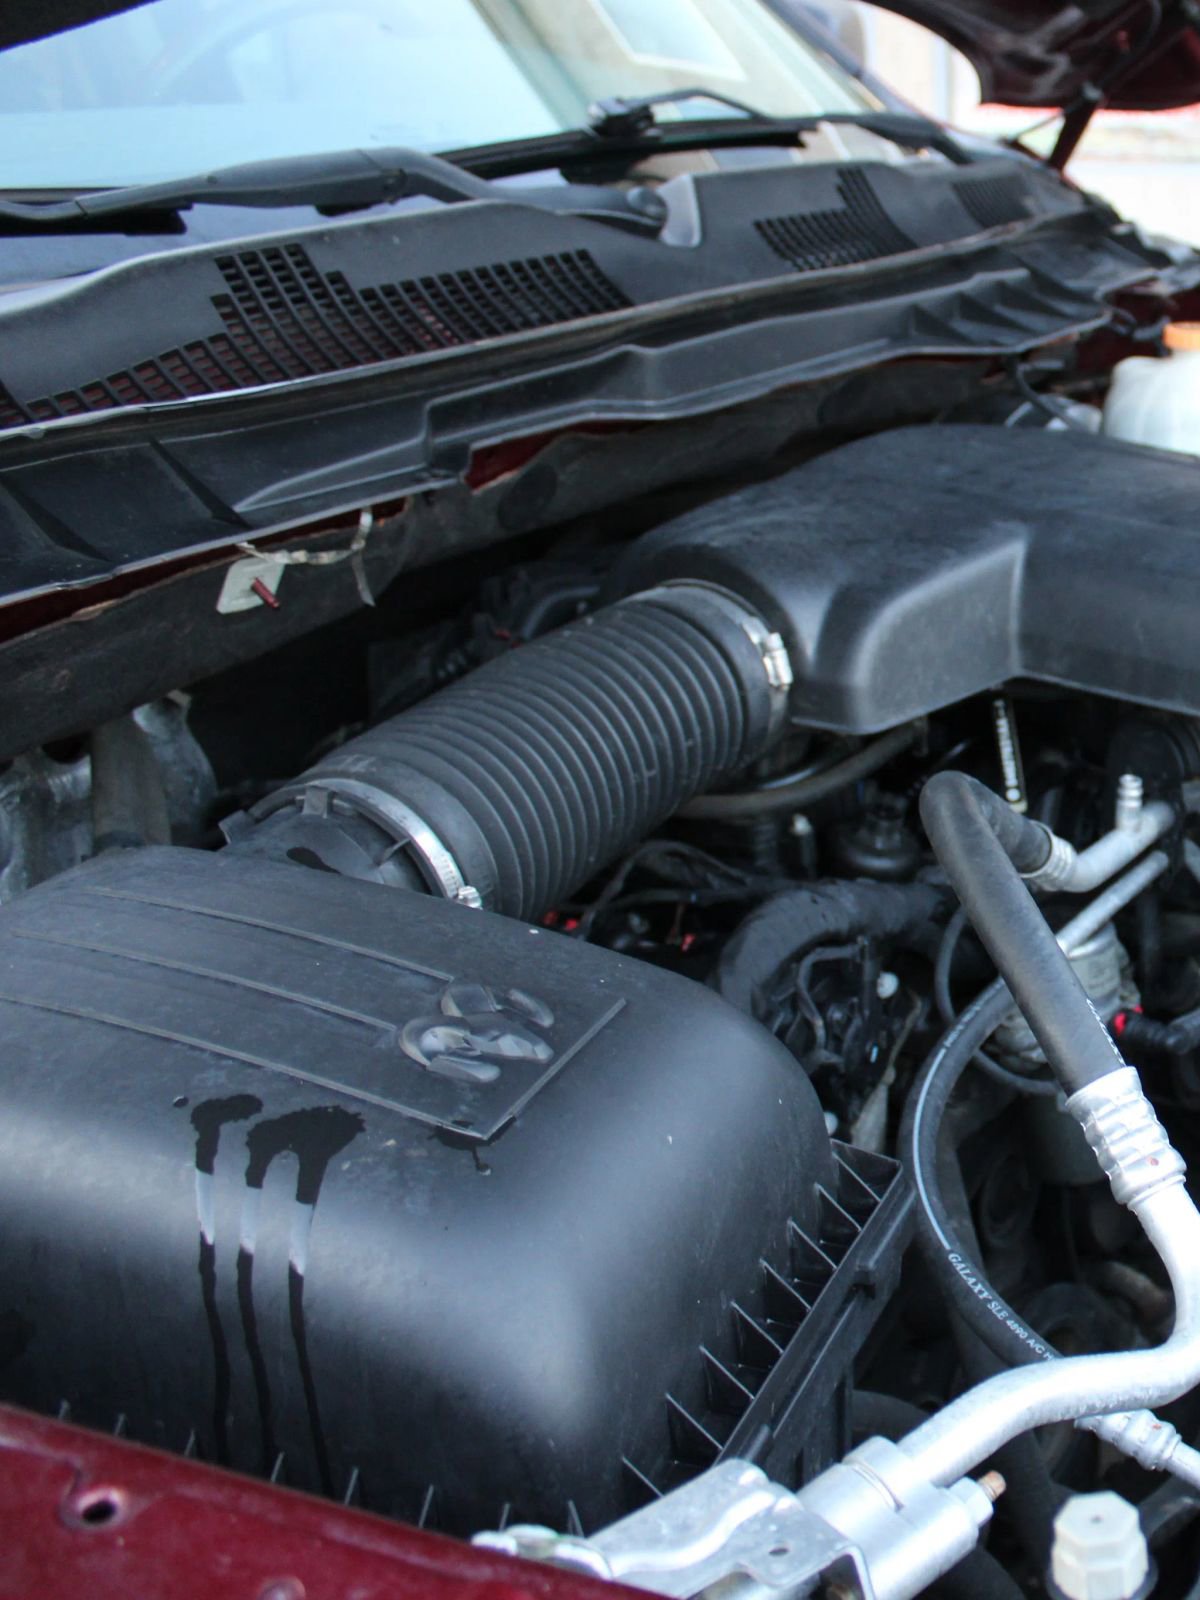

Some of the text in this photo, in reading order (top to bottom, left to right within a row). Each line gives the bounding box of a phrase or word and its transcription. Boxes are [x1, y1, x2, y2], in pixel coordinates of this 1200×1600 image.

[947, 1253, 992, 1300] GALAXY
[987, 1301, 1009, 1320] SLE
[1006, 1319, 1028, 1339] 4890
[1026, 1339, 1045, 1353] A/C
